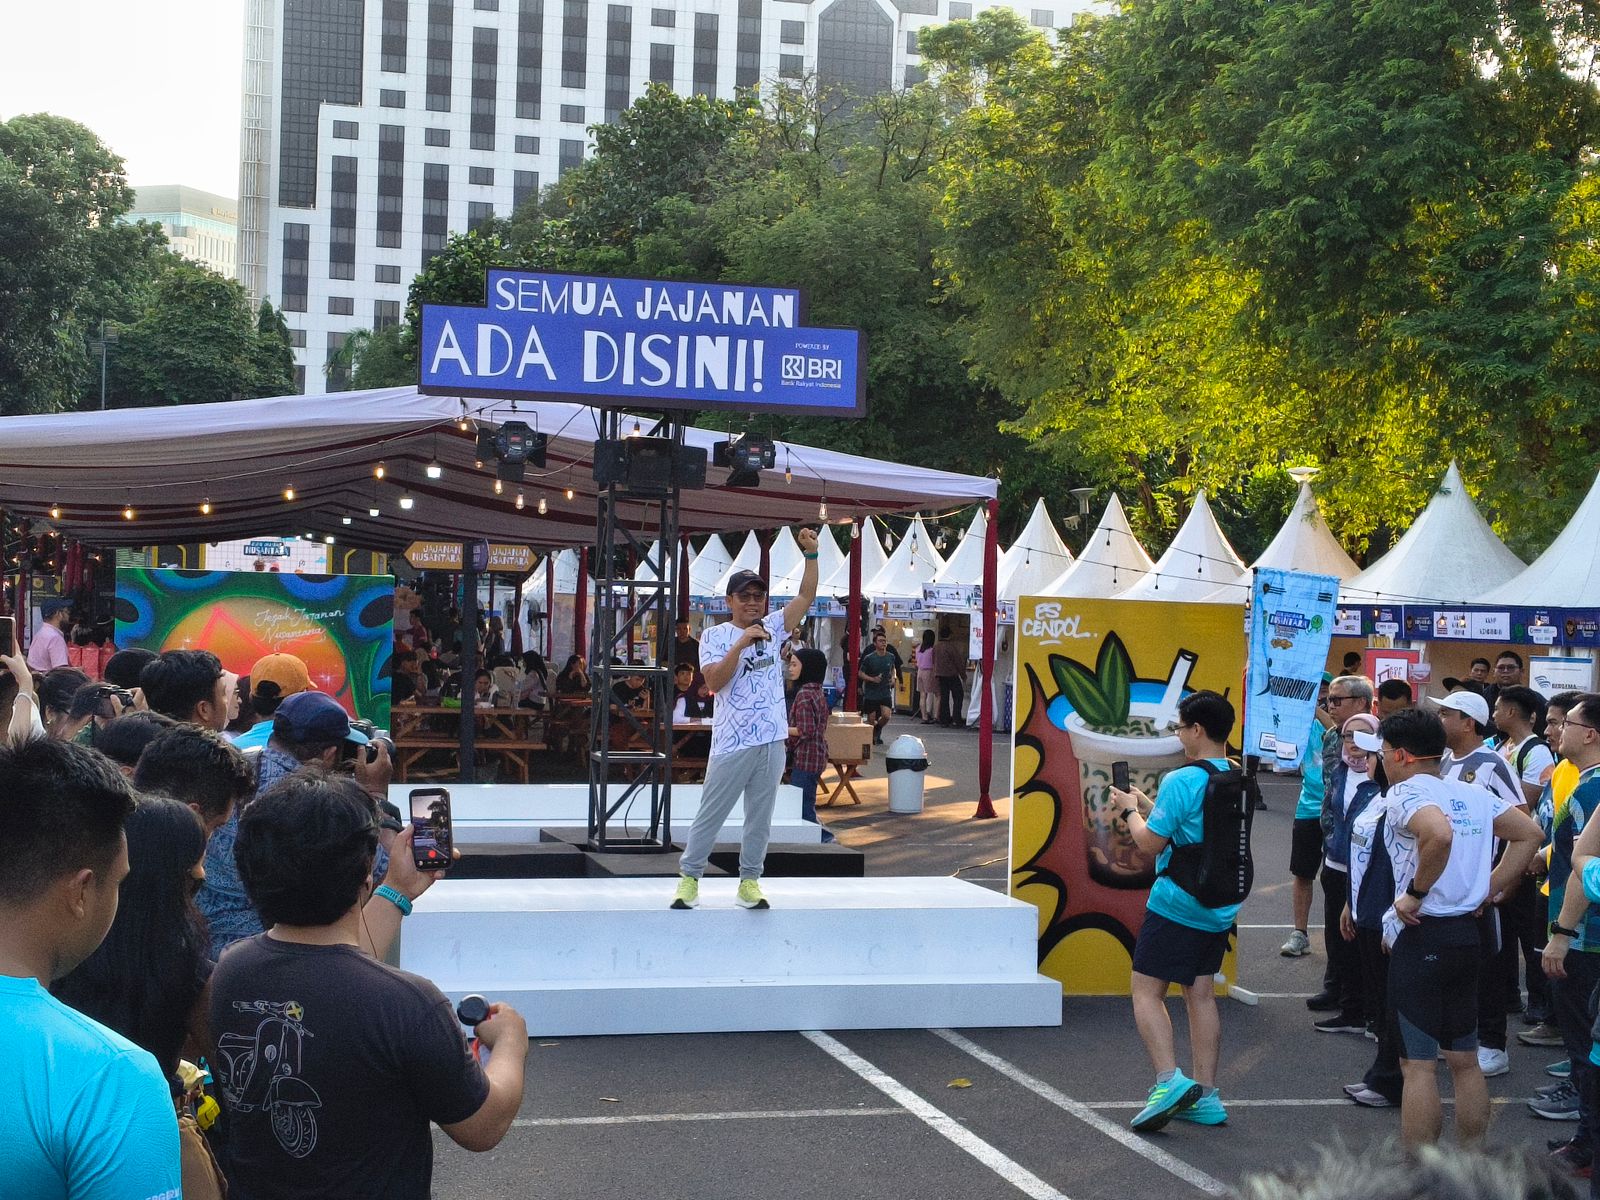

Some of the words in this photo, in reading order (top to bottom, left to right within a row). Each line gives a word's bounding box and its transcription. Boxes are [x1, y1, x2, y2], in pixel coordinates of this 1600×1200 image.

[495, 276, 623, 318] SEMUA
[636, 286, 795, 329] JAJANAN
[430, 319, 557, 381] ADA
[583, 330, 765, 394] DISINI!
[808, 358, 842, 379] BRI
[423, 545, 461, 554] JAJANAN
[492, 548, 529, 557] JAJANAN
[412, 553, 461, 563] NUSANTARA
[489, 556, 529, 565] USANTARA
[1035, 602, 1062, 620] ES
